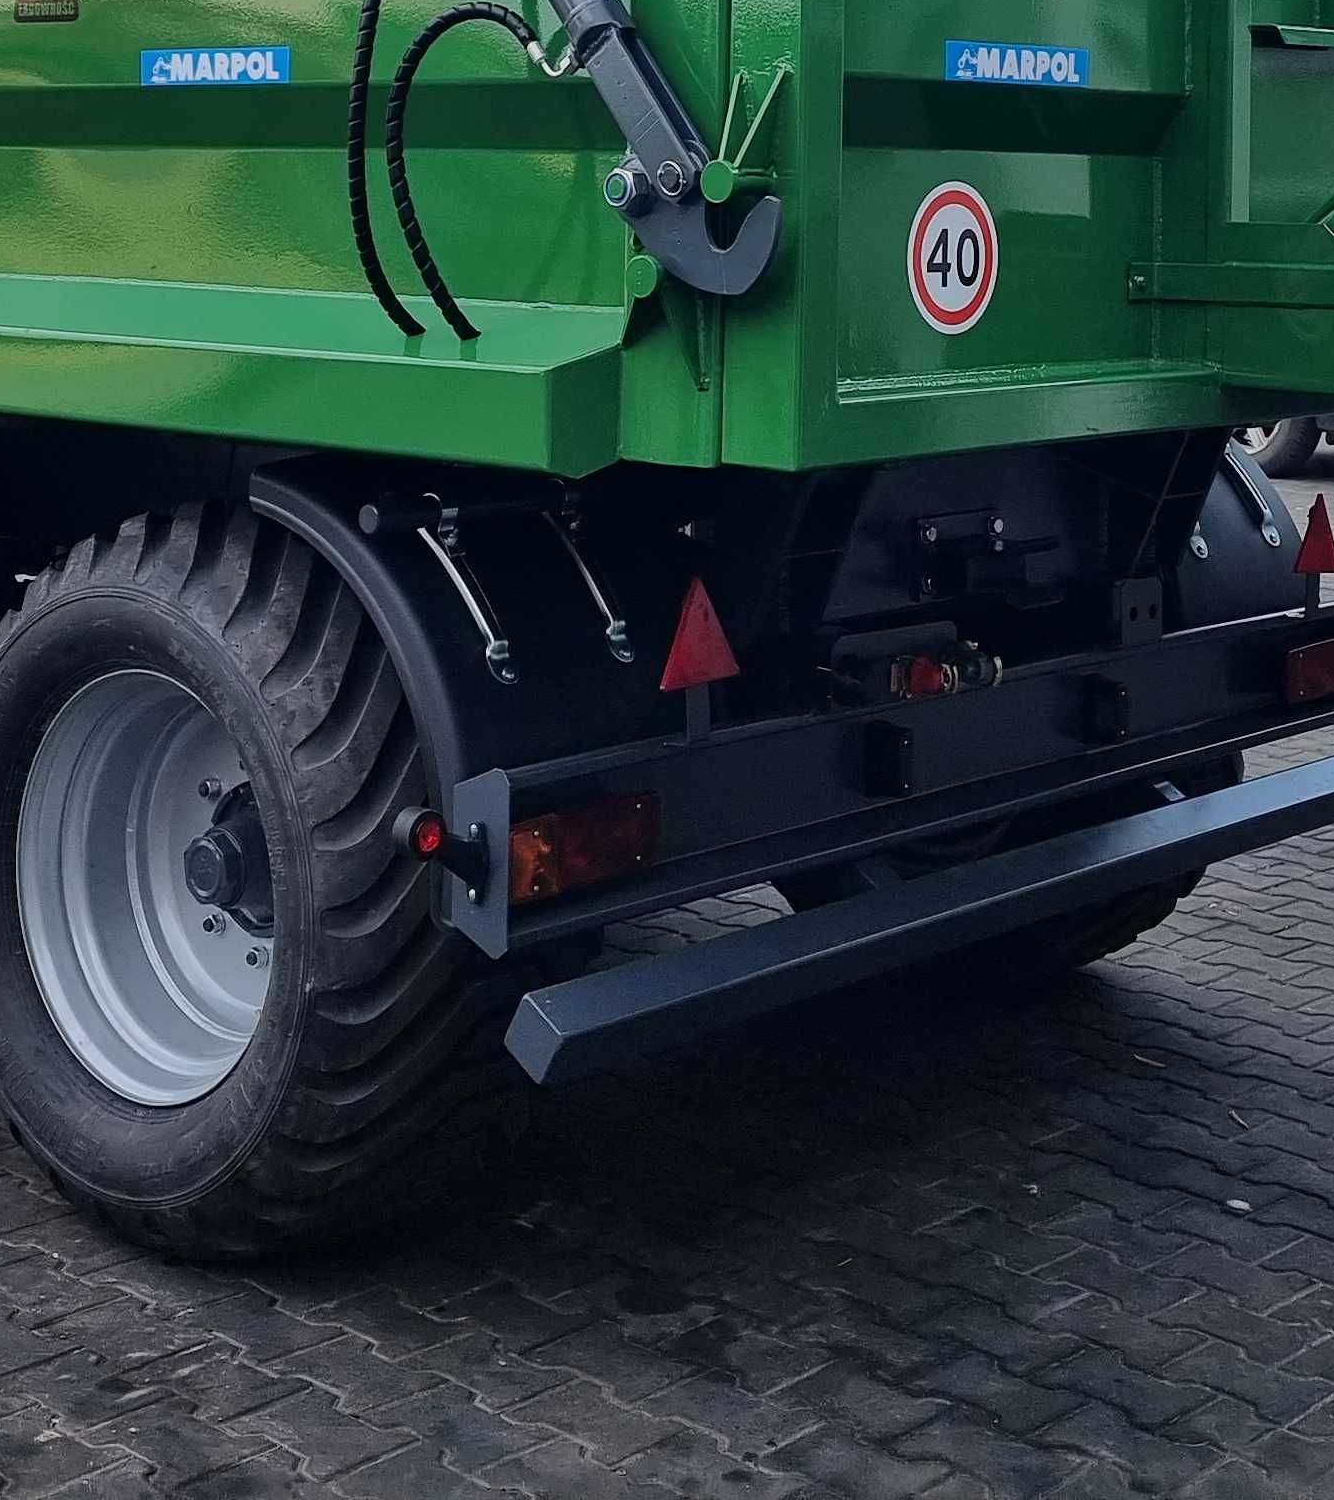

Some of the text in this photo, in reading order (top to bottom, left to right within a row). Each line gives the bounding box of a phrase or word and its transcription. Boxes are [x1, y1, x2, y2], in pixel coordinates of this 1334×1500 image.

[170, 51, 280, 82] MARPOL
[976, 46, 1080, 83] MARPOL
[927, 228, 980, 288] 40
